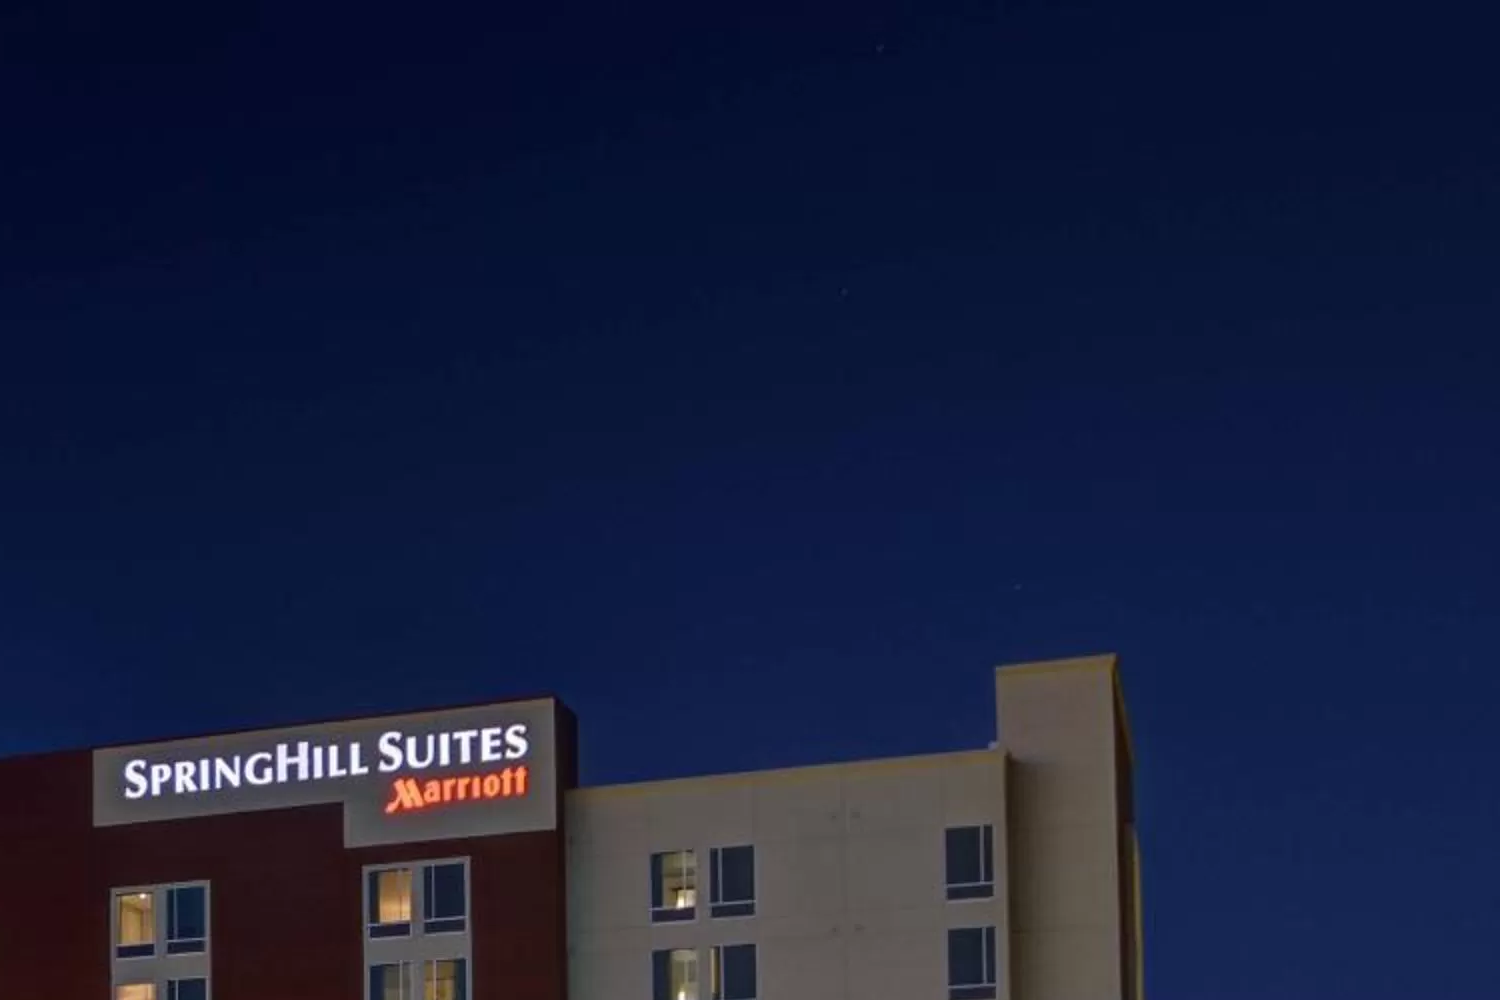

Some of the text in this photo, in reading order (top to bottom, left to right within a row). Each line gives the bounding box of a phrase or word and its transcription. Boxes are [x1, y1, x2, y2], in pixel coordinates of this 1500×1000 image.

[123, 724, 529, 799] SPRINGHILL SUITES
[384, 765, 529, 815] Marriott
